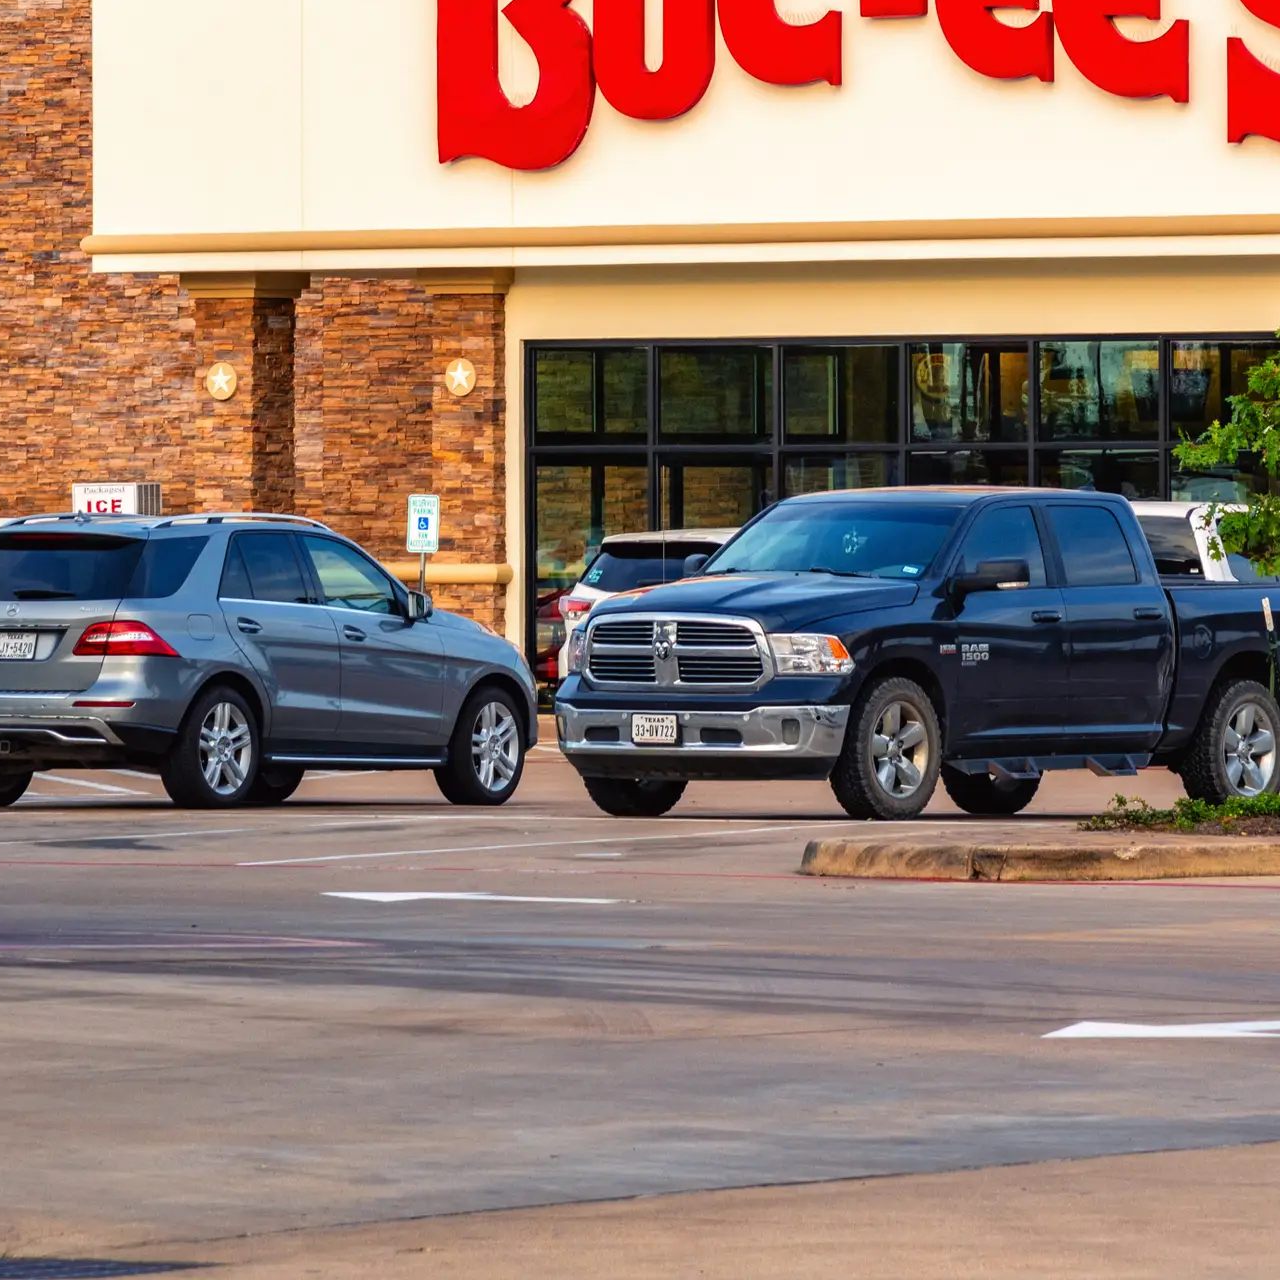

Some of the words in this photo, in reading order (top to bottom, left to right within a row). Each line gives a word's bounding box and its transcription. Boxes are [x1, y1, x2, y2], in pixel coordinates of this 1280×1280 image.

[87, 499, 122, 513] ICE
[961, 643, 989, 652] RAM
[961, 652, 989, 660] 1500
